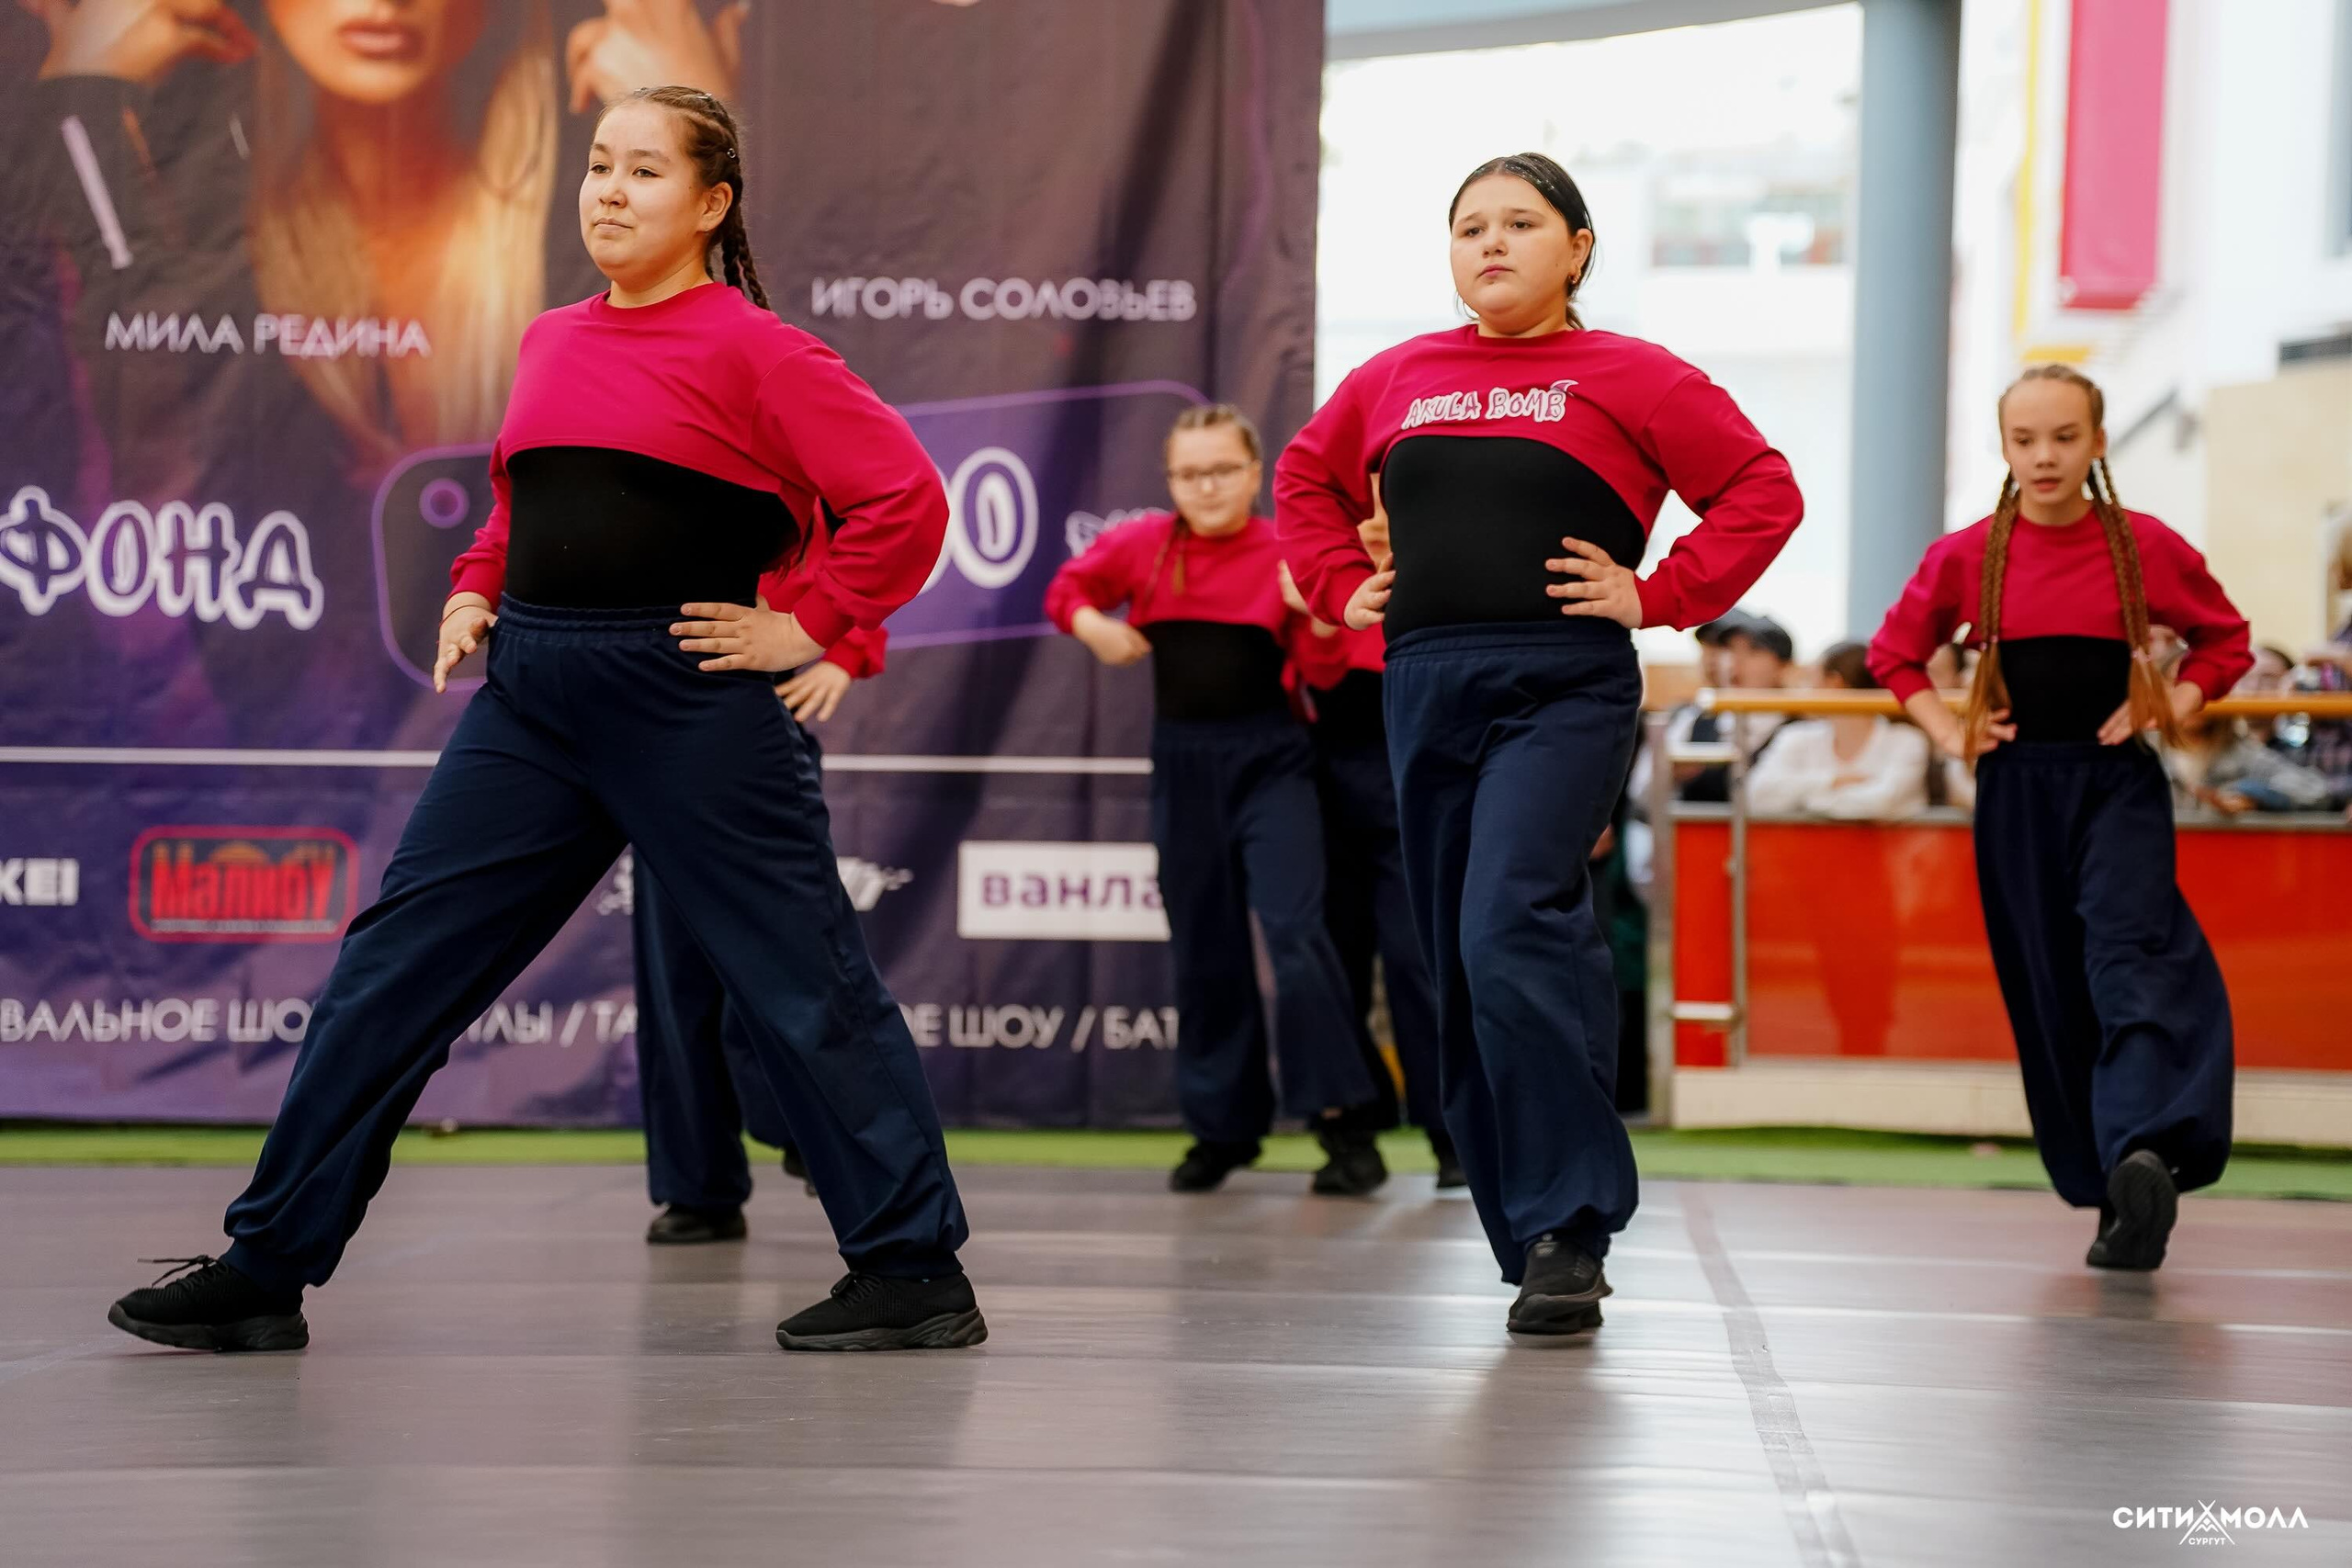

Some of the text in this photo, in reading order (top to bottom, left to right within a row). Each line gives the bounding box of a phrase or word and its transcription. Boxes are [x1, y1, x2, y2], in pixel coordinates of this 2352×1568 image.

[812, 276, 1196, 321] ИГОРЬ СОЛОВЬЕВ
[105, 311, 432, 358] МИЛА РЕДИНА
[1401, 387, 1566, 429] AKULA BOMB
[949, 1003, 1065, 1049] ШОУ
